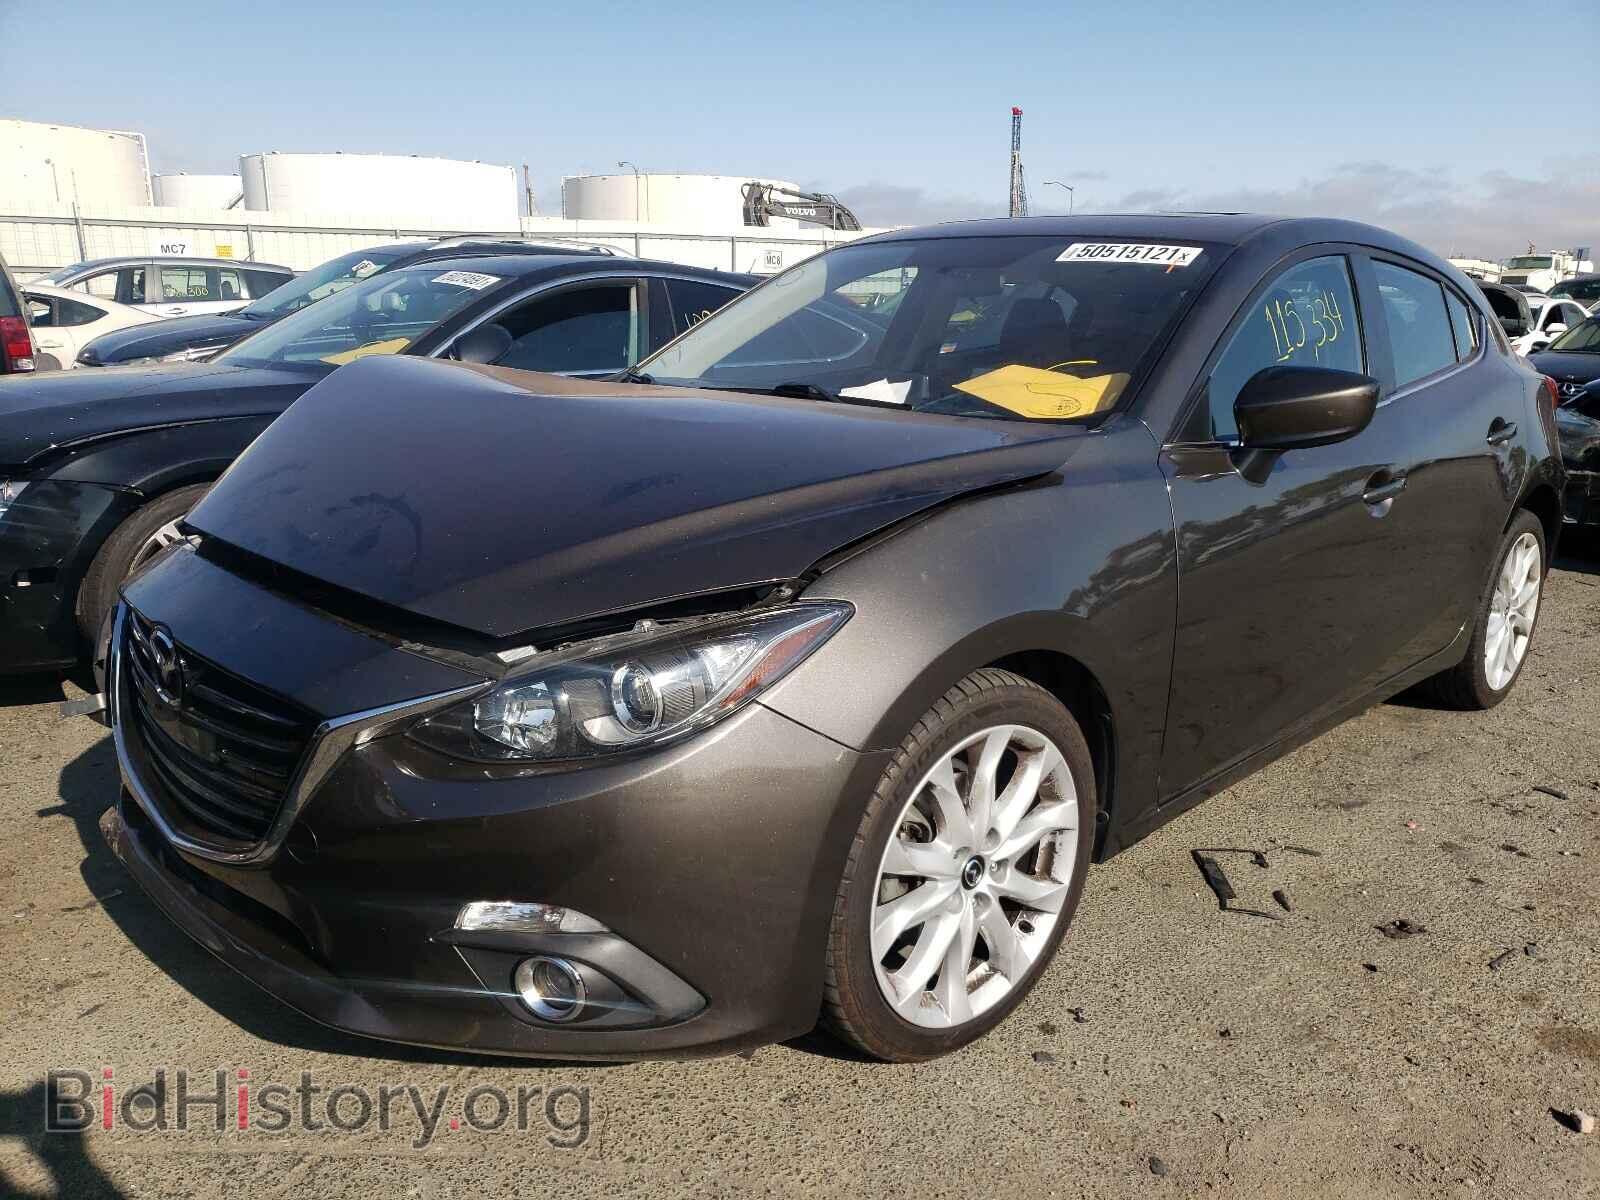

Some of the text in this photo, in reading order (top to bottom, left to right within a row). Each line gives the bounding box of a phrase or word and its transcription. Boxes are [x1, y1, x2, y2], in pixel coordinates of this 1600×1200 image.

[784, 207, 816, 216] VOLVO
[160, 244, 186, 254] MC7
[1077, 245, 1180, 261] 50515121
[766, 255, 781, 266] MC8
